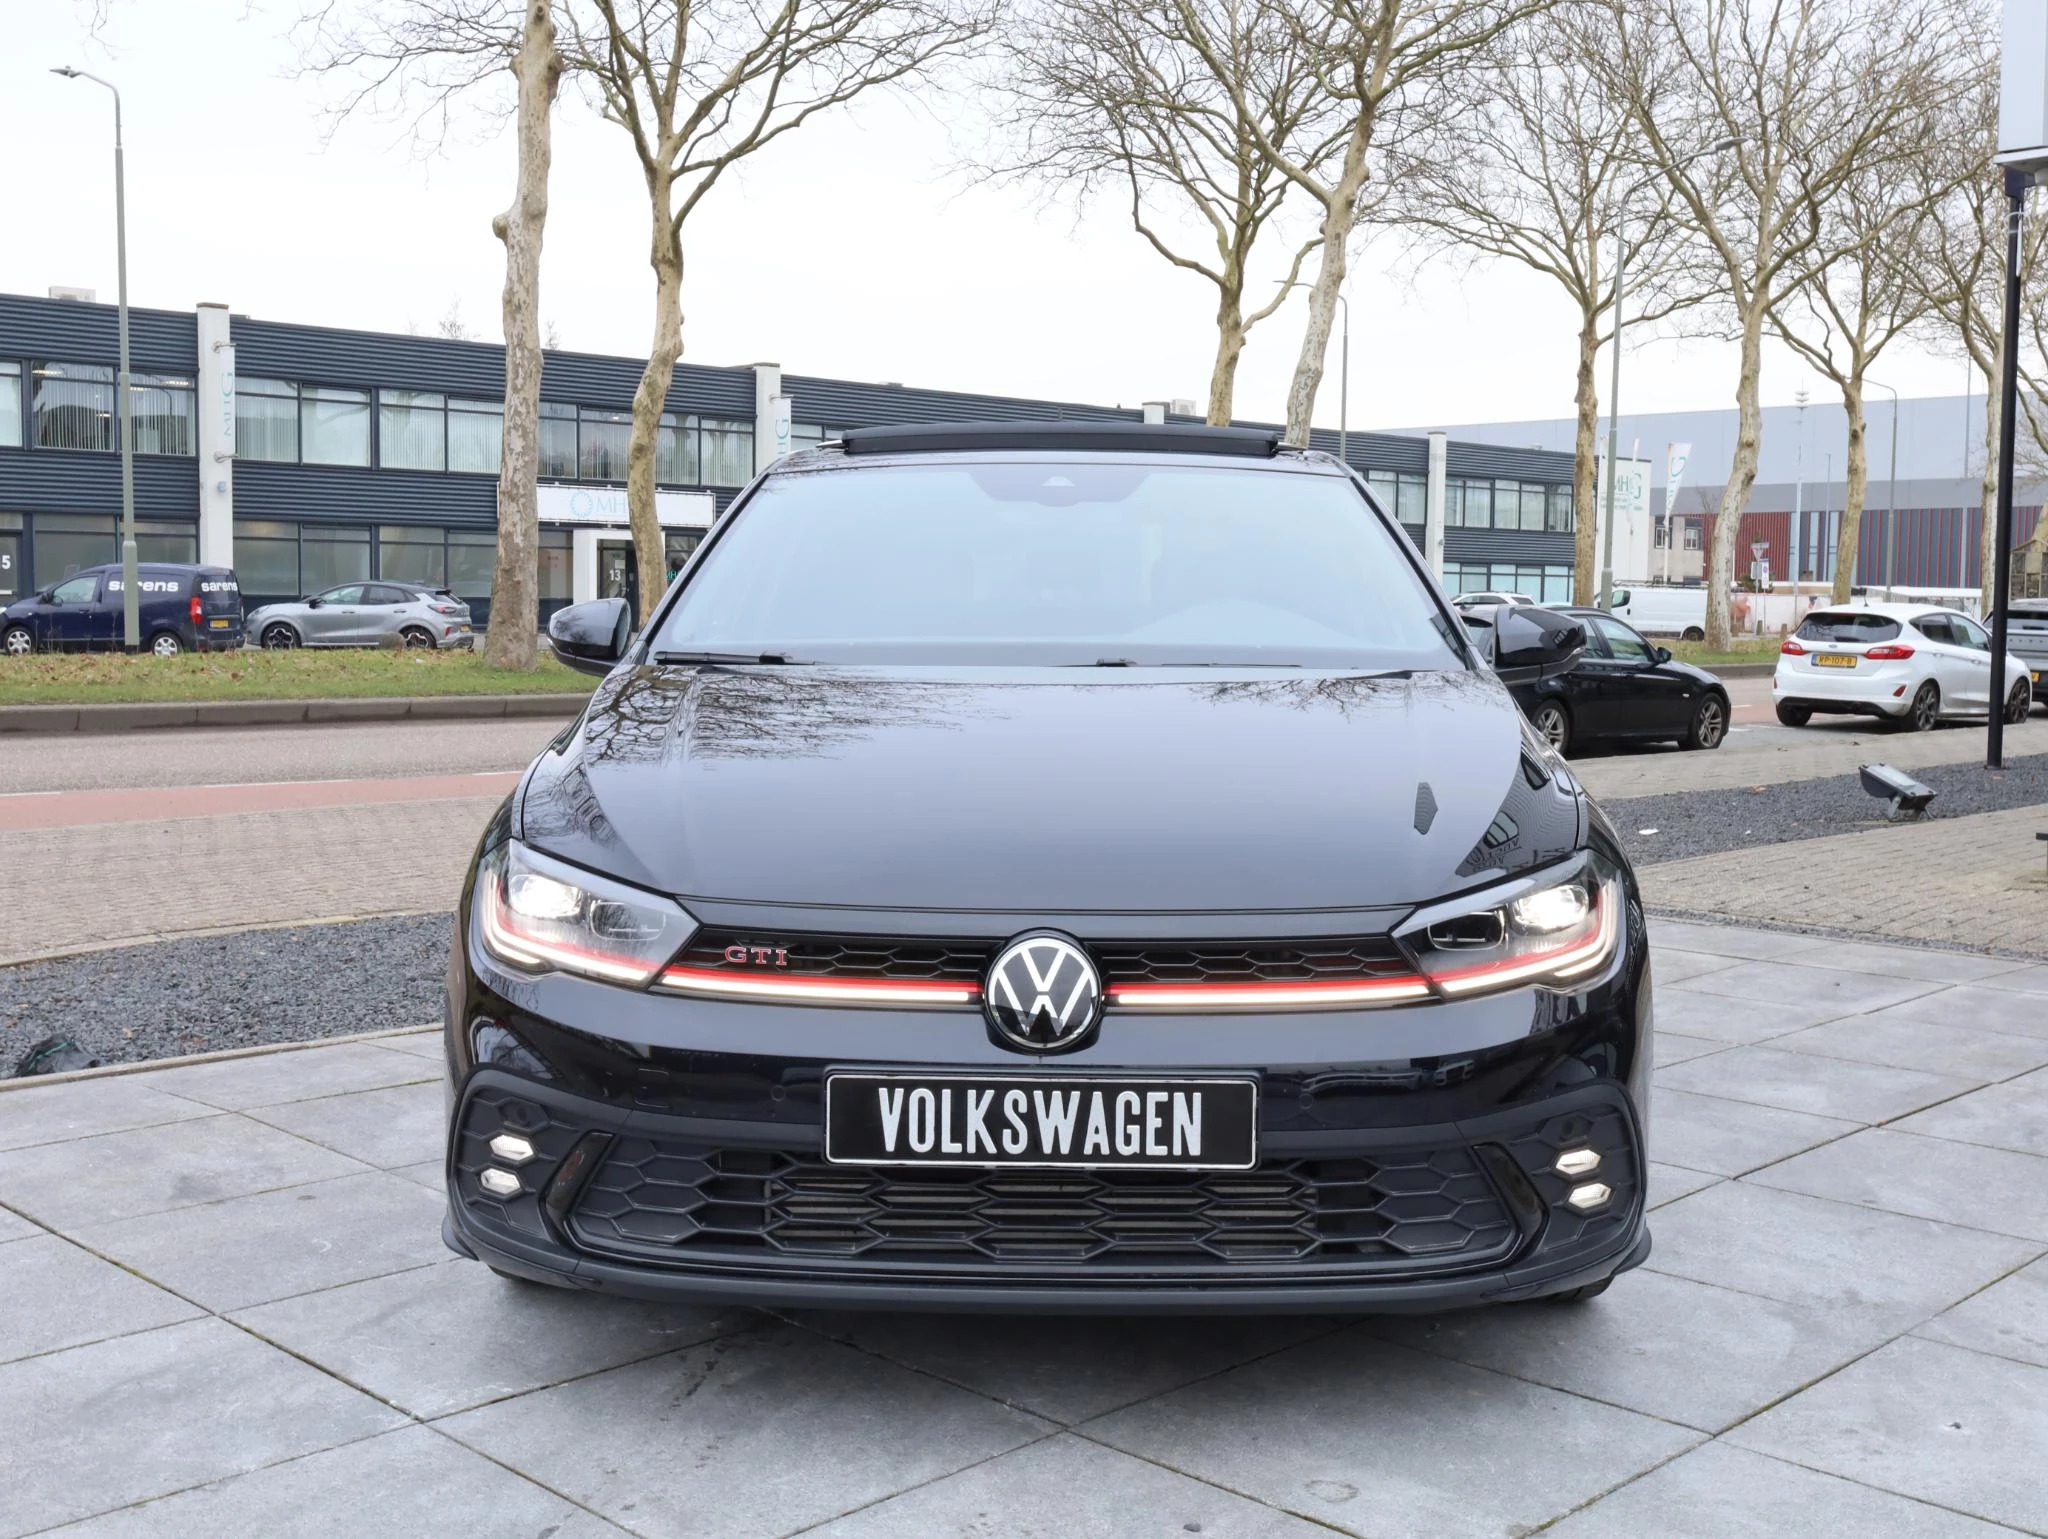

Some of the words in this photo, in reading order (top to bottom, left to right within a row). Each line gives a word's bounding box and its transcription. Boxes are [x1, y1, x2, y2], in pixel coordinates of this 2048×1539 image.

[596, 496, 627, 513] MH
[609, 569, 621, 581] 13
[108, 580, 179, 593] sens
[201, 581, 238, 592] sarens
[724, 945, 788, 966] GTI
[878, 1087, 1202, 1157] VOLKSWAGEN
